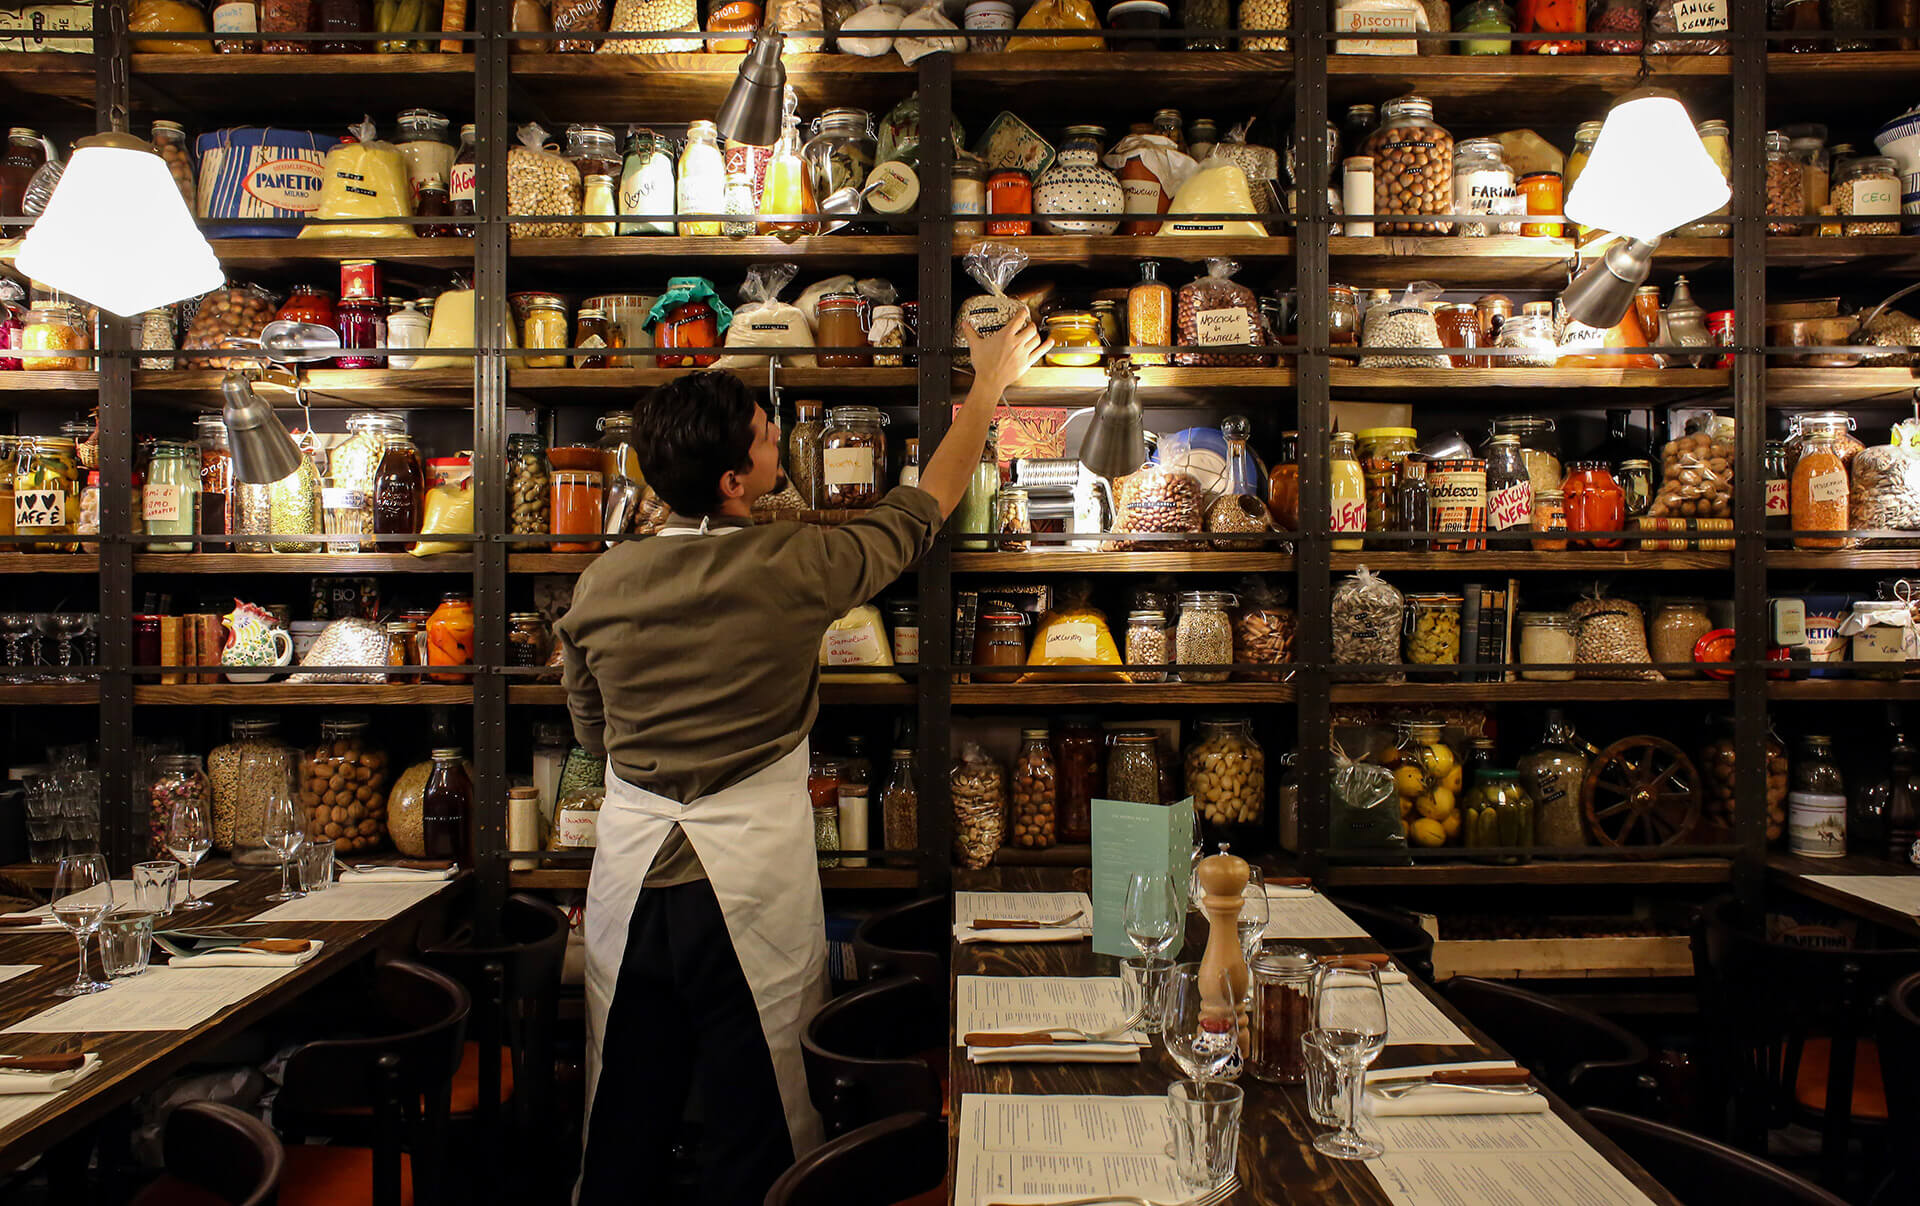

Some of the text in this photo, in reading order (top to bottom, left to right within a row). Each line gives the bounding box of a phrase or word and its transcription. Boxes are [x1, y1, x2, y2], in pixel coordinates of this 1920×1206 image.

[1681, 3, 1715, 16] ANICE
[1350, 13, 1409, 30] BISCOTTI
[256, 172, 324, 192] PANETTO
[1861, 191, 1892, 204] CECI
[333, 590, 355, 604] BIO
